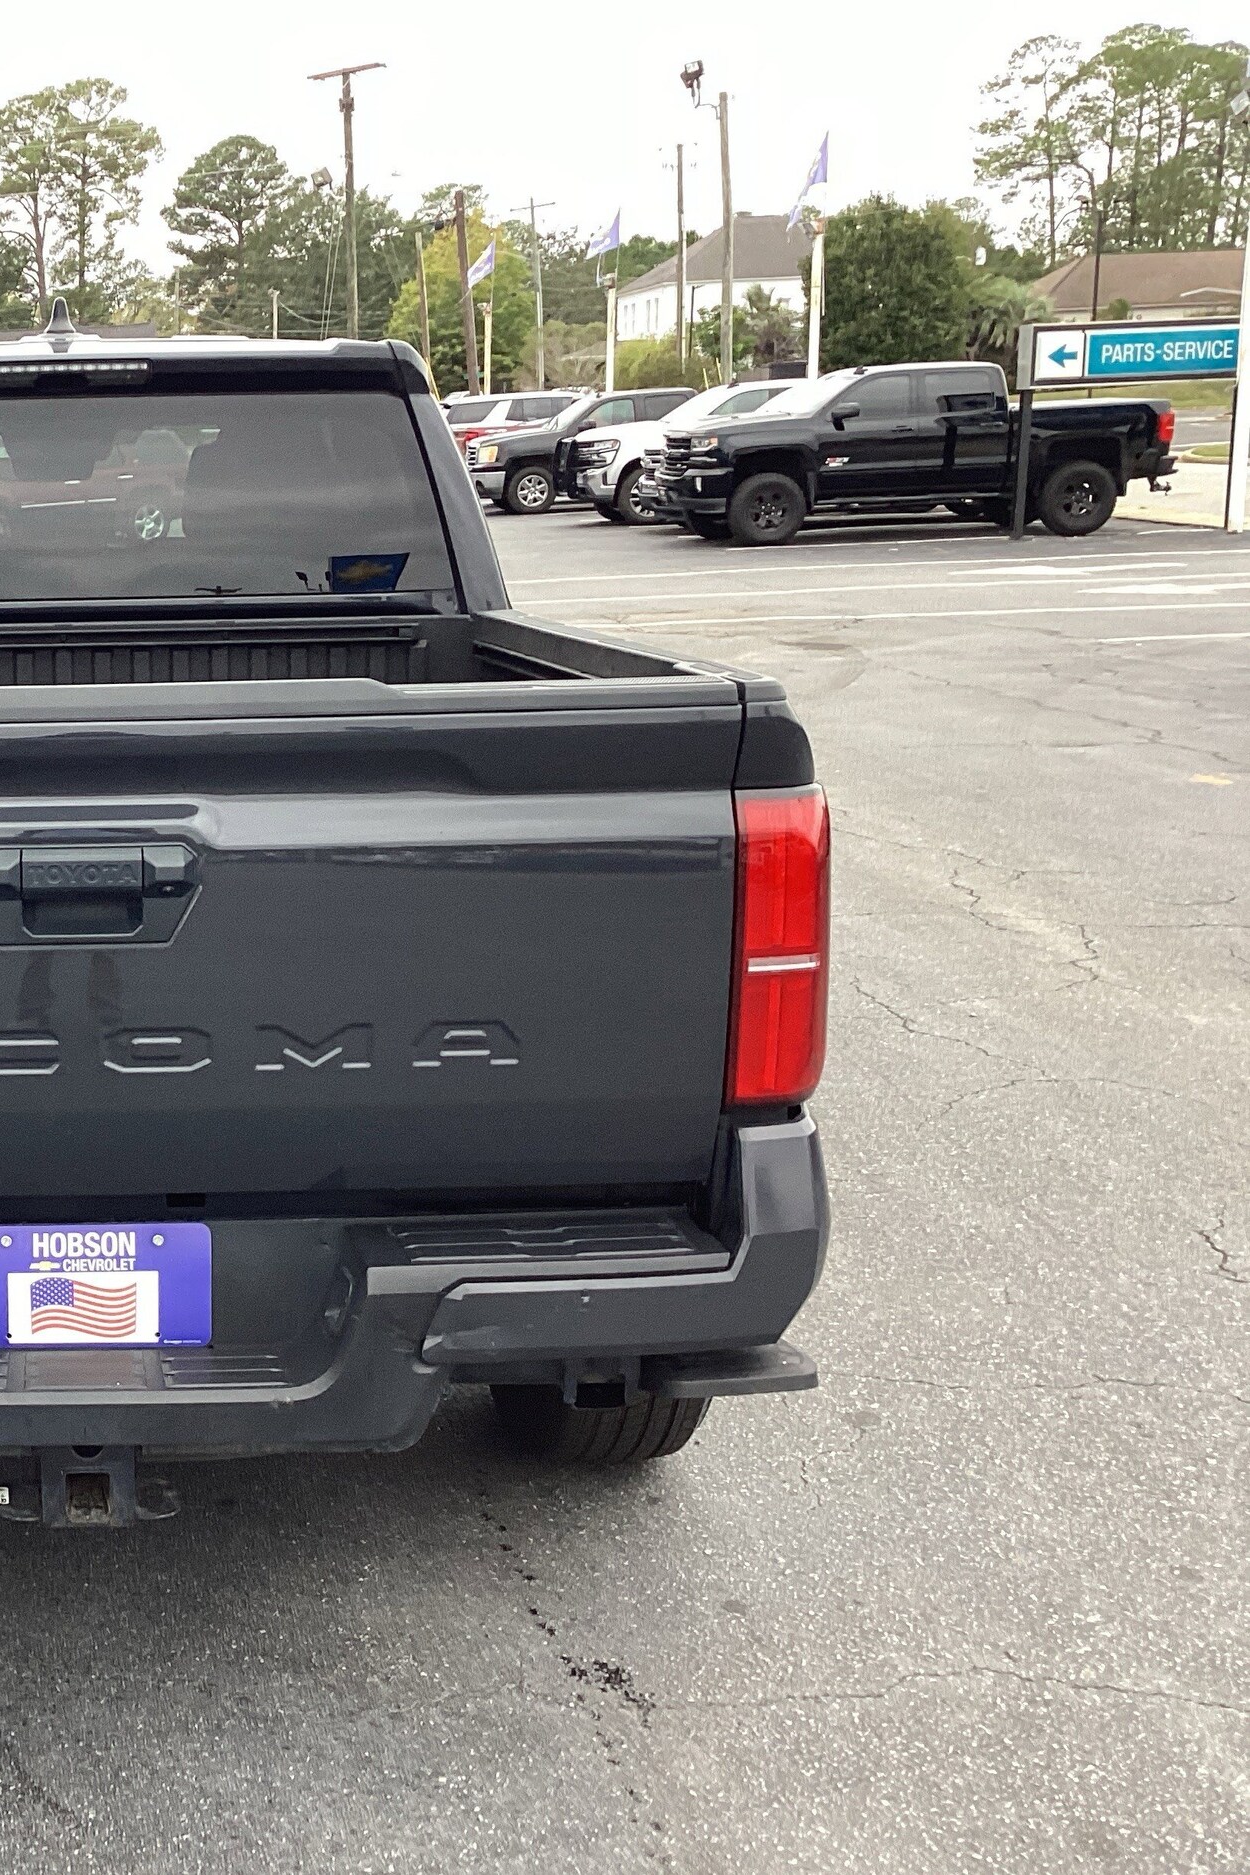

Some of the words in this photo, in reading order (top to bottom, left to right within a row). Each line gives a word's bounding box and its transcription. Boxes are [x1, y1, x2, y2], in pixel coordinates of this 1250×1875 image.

[1101, 339, 1235, 364] PARTS-SERVICE
[27, 863, 138, 886] TOYOTA
[32, 1231, 136, 1258] HOBSON
[62, 1258, 136, 1272] CHEVROLET
